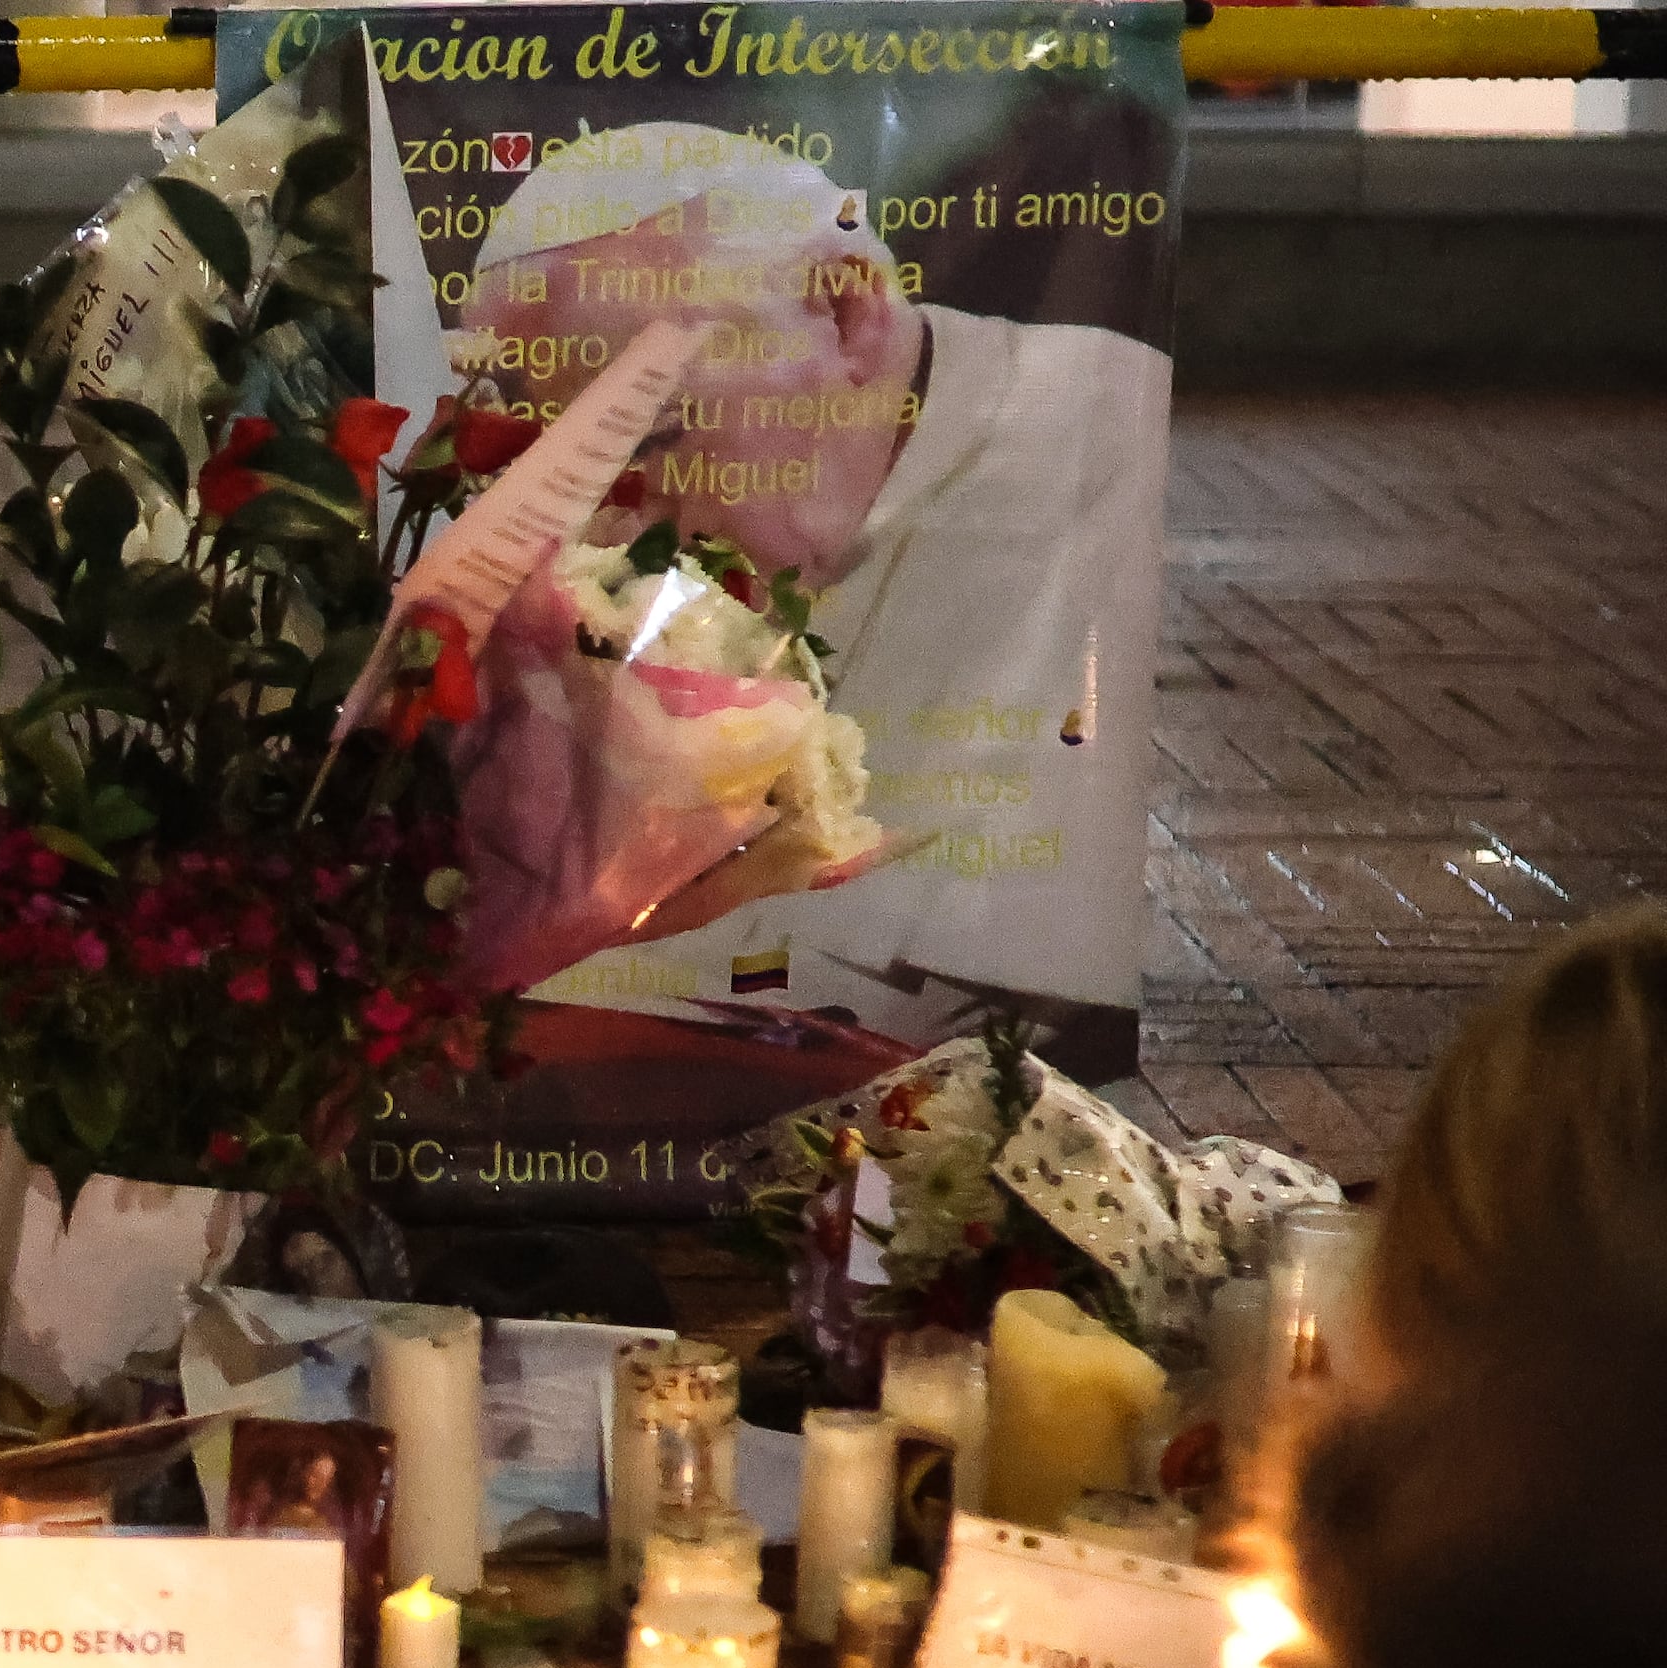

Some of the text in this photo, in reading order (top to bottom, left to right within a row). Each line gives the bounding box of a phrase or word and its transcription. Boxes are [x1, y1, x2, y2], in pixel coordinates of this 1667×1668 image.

[264, 10, 552, 83] Oacion
[575, 6, 662, 80] de
[403, 128, 489, 173] zón
[664, 122, 833, 176] partido
[416, 194, 516, 241] ción
[880, 194, 958, 241] por
[971, 183, 1000, 229] ti
[1015, 181, 1166, 238] amigo
[507, 261, 548, 302] la
[679, 392, 724, 431] tu
[660, 449, 820, 507] Miguel
[370, 1139, 458, 1183] DC:
[478, 1139, 609, 1183] Junio
[629, 1140, 675, 1182] 11
